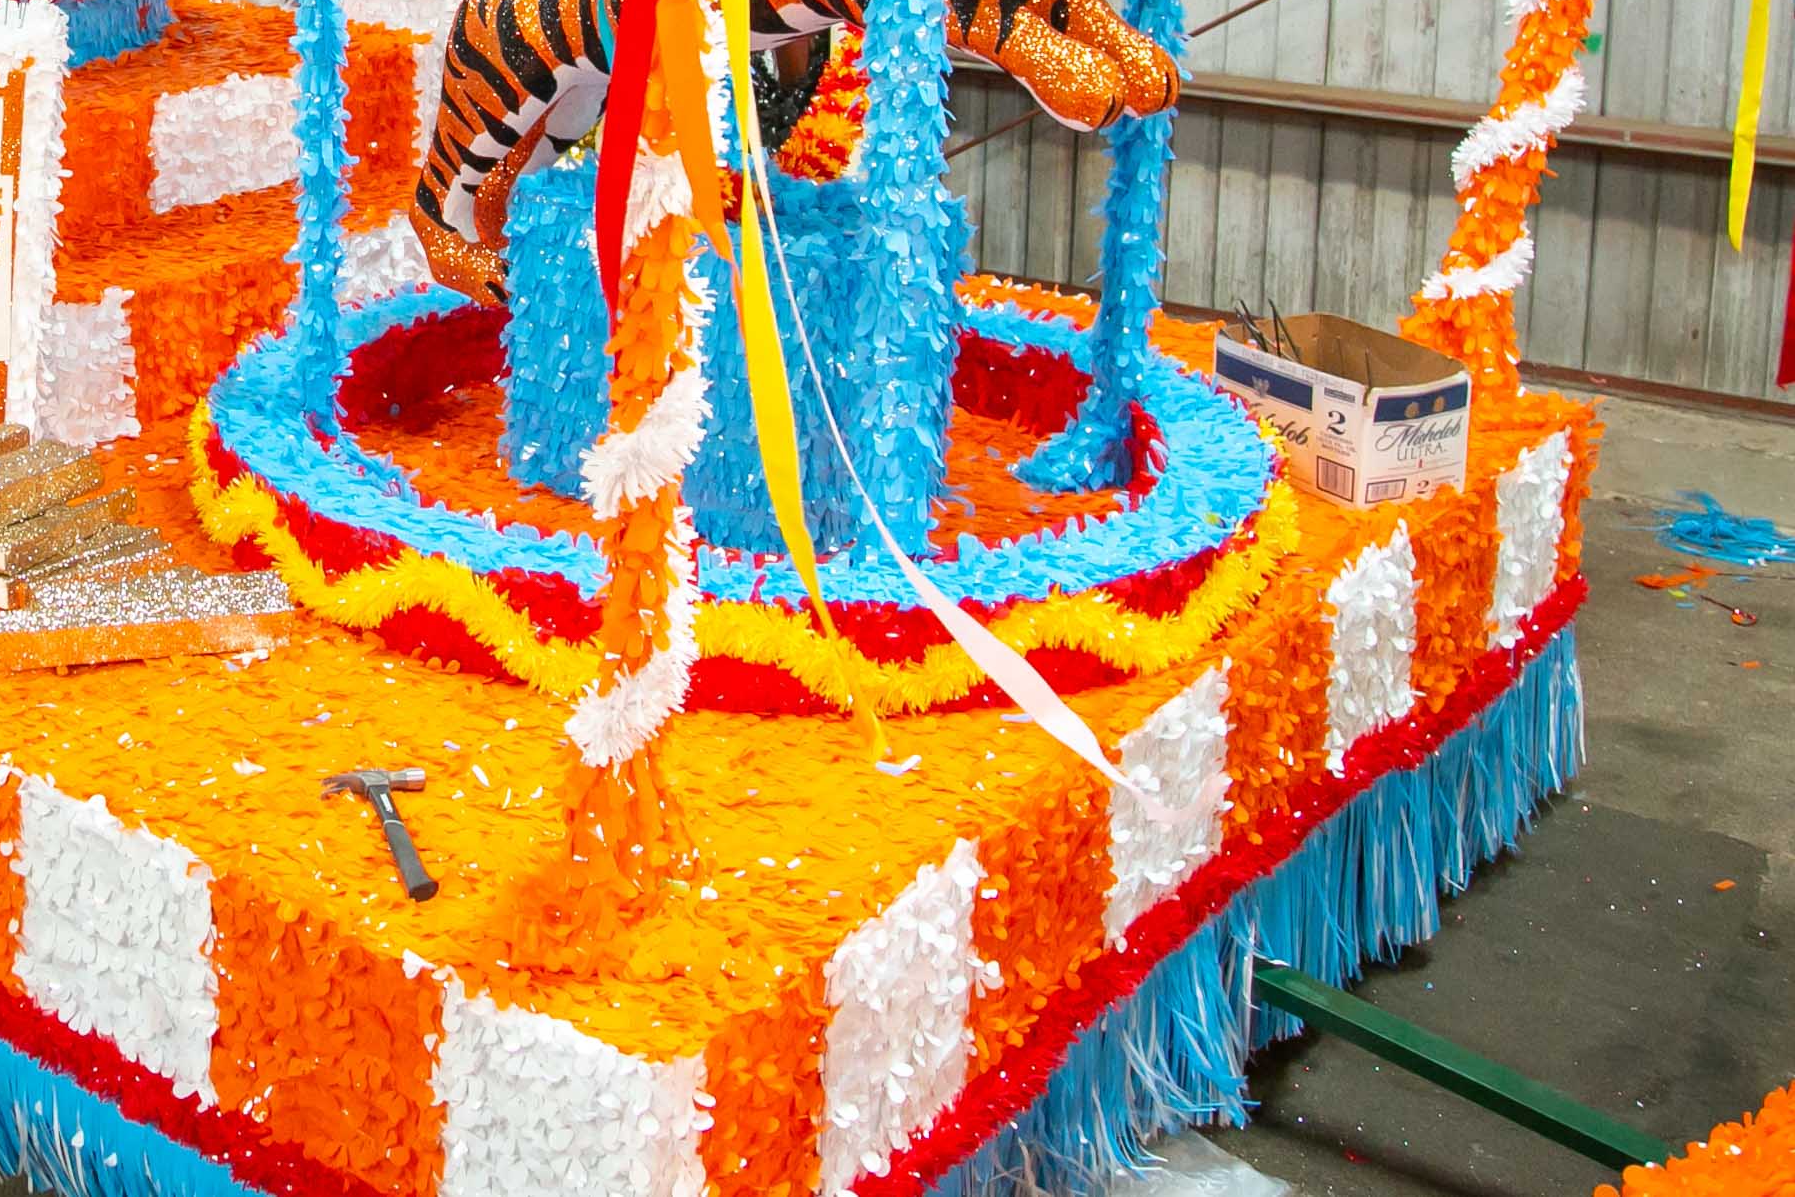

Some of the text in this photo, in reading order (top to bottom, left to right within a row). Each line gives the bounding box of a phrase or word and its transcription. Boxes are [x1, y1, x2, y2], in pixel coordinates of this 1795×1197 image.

[1327, 410, 1346, 435] 2
[1375, 415, 1463, 451] Michelob
[1397, 442, 1443, 461] ULTRA
